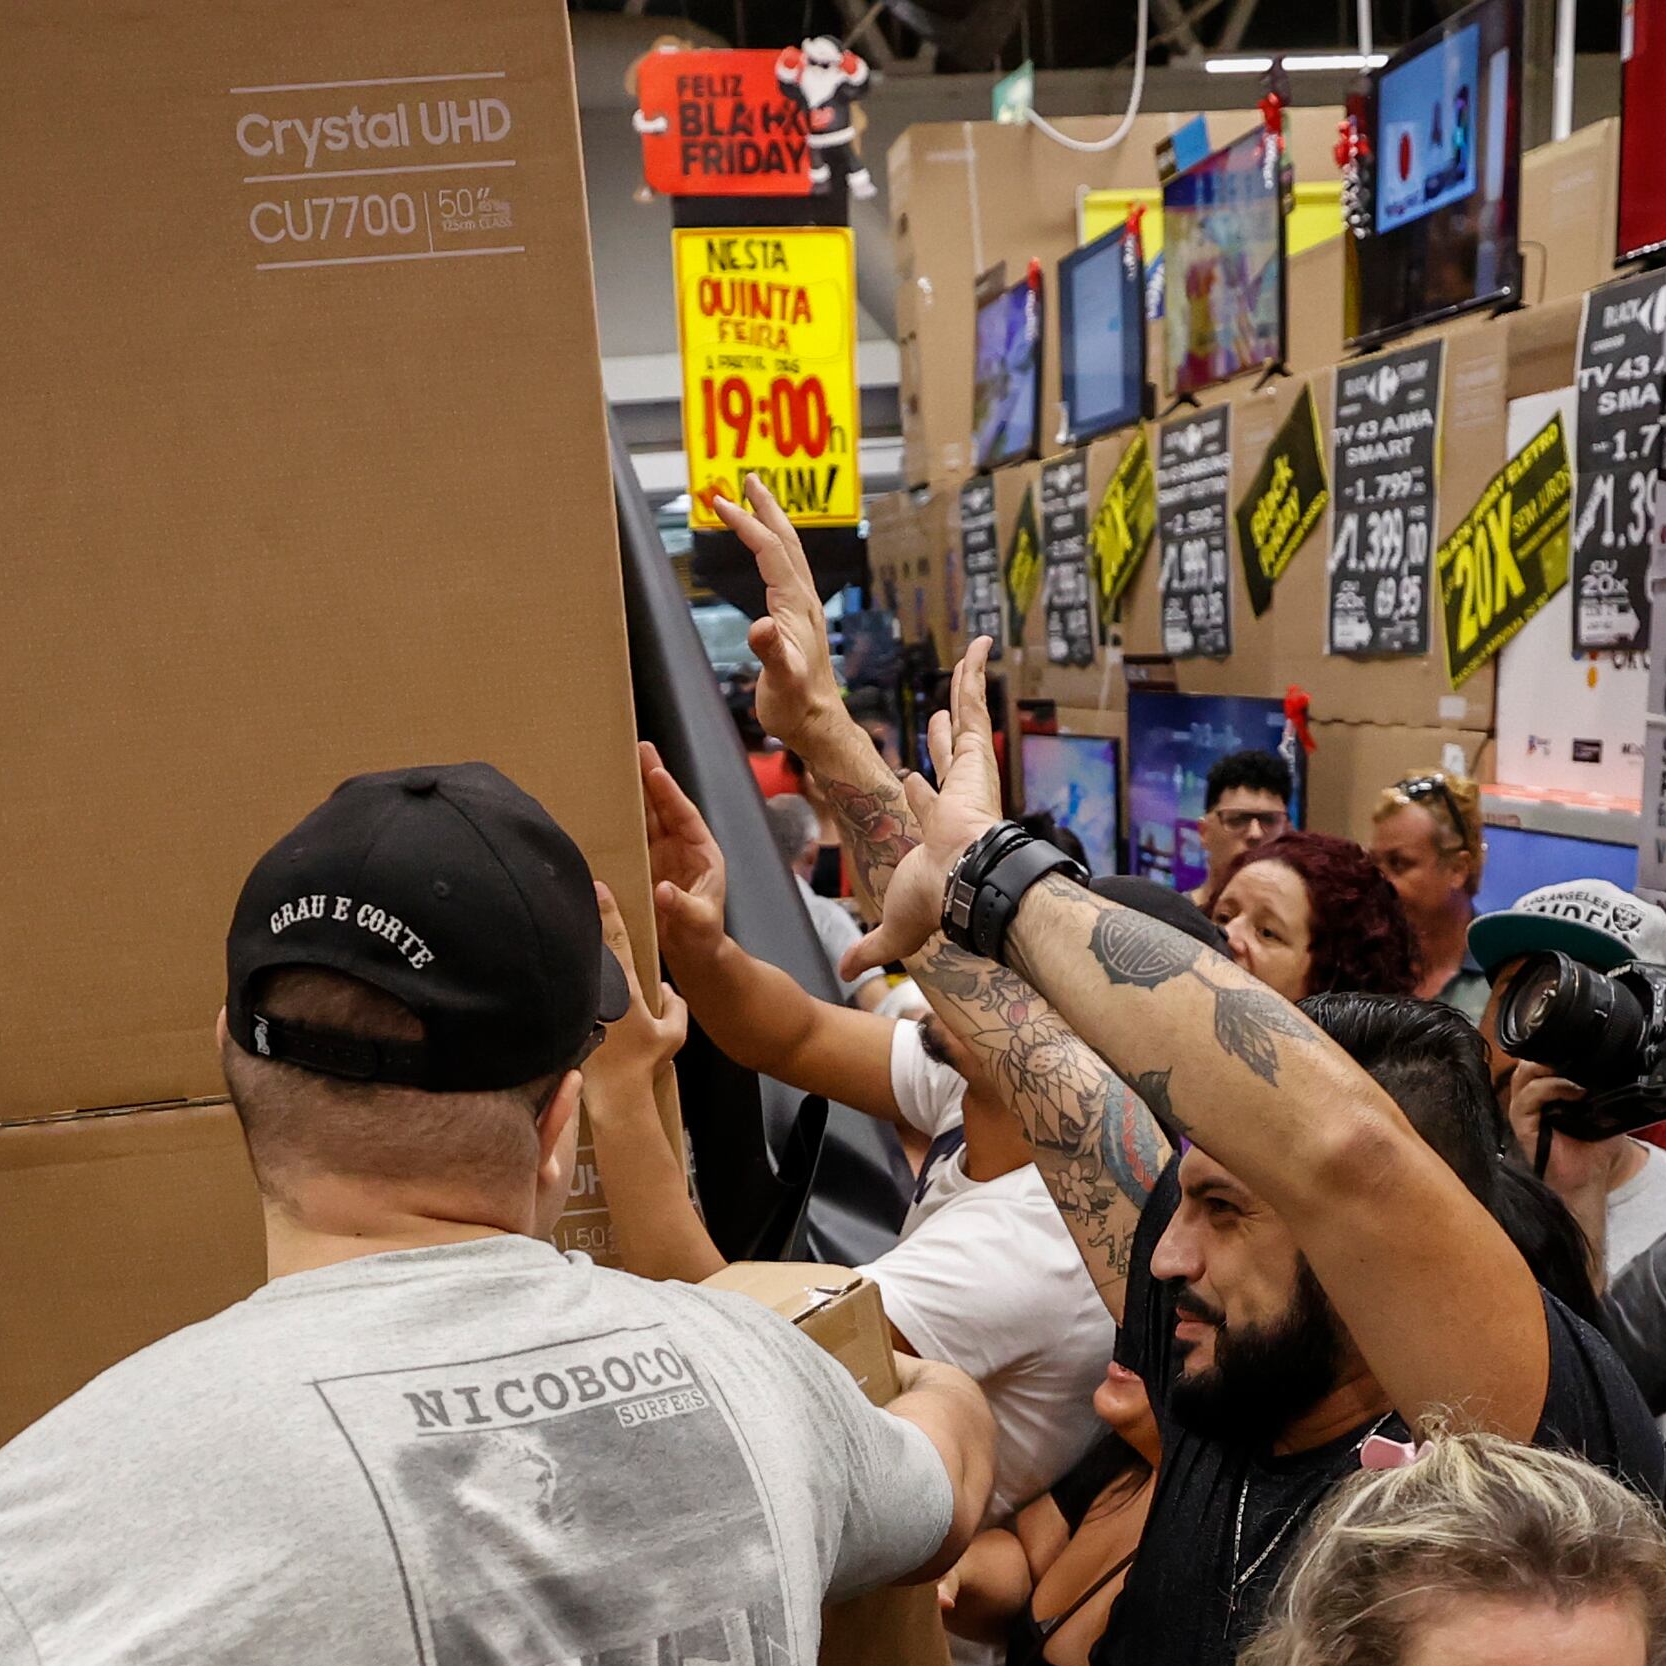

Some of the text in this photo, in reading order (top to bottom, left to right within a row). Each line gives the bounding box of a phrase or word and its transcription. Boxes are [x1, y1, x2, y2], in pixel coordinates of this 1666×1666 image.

[677, 75, 743, 97] FELIZ
[236, 98, 511, 168] Crystal UHD
[682, 139, 806, 176] FRIDAY
[249, 192, 415, 243] CU7700
[706, 238, 788, 274] NESTA
[699, 276, 812, 325] QUINTA
[718, 320, 791, 353] FEIRA
[1580, 354, 1650, 391] TV 43
[1334, 425, 1354, 447] TV
[1355, 418, 1379, 441] 43
[1345, 435, 1415, 468] SMART
[1454, 489, 1527, 652] 20X
[1549, 890, 1611, 910] ANGELES
[270, 894, 435, 970] GRAU E CORTE
[403, 1346, 688, 1430] NICOBOCO
[619, 1389, 706, 1428] SURFERS
